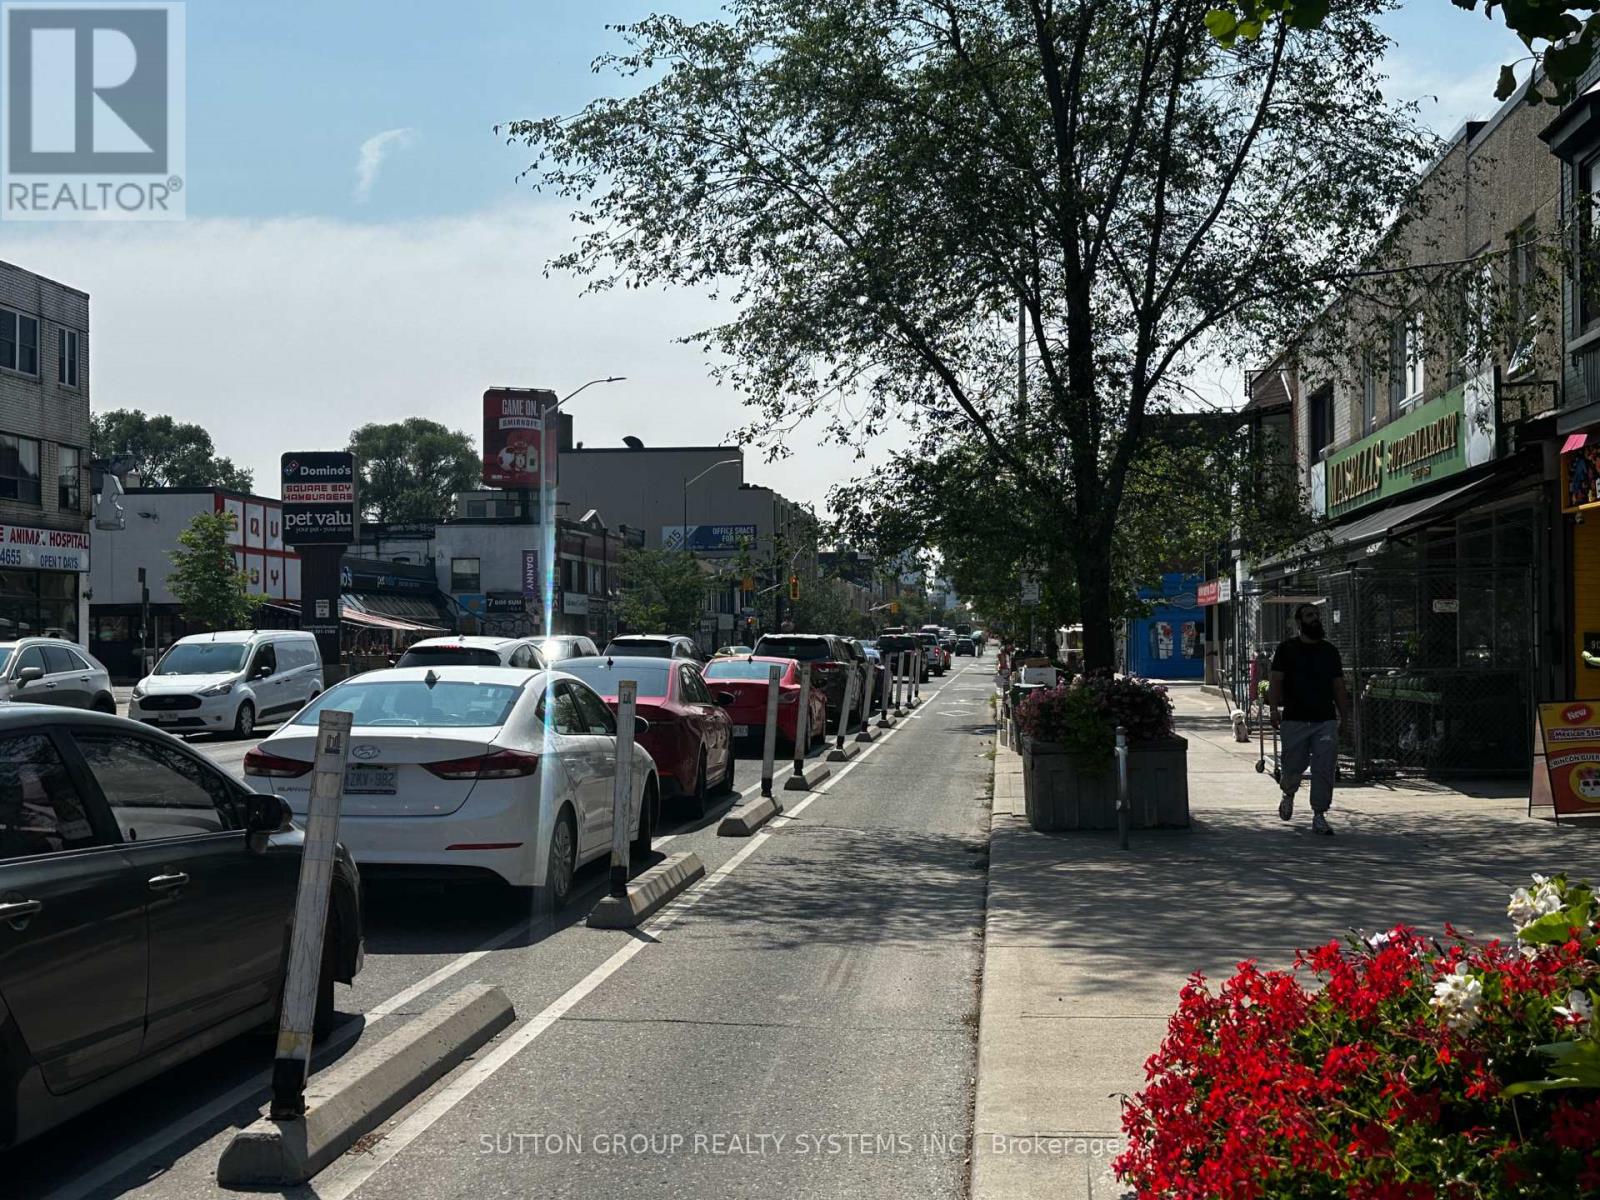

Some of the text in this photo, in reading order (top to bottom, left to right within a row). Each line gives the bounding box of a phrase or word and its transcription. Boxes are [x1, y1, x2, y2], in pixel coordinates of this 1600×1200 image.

[502, 399, 524, 415] GAME
[1386, 411, 1458, 473] SUPERMARKET
[300, 465, 352, 476] Domino's
[286, 484, 351, 493] SQUARE BOY
[283, 493, 353, 501] HAMBURGERS
[284, 510, 352, 530] pet valu
[712, 527, 754, 536] OFFICE SPACE
[49, 532, 89, 549] HOSPITAL
[40, 555, 56, 568] OPEN
[63, 558, 79, 569] DAYS
[526, 556, 534, 590] DANNY
[1566, 709, 1586, 720] New
